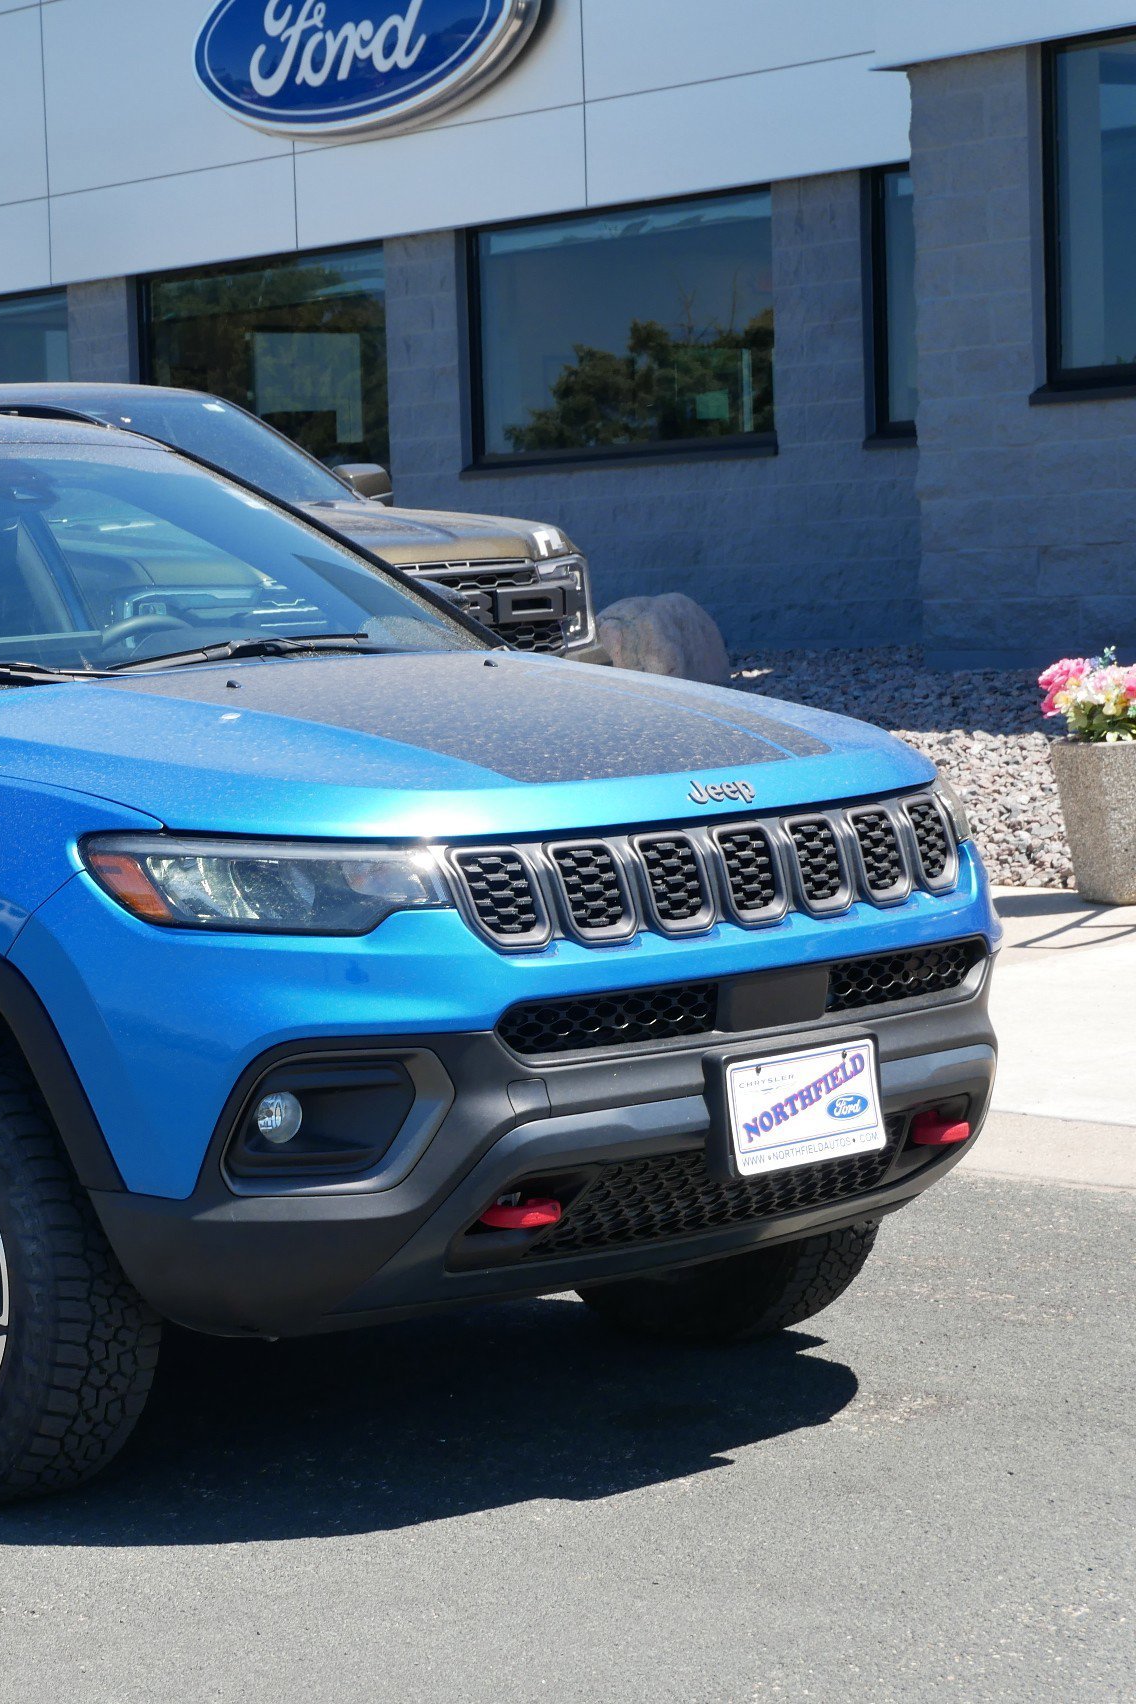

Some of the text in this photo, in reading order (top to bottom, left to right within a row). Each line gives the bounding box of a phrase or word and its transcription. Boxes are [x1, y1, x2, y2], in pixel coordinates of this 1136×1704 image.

[250, 0, 426, 97] Ford
[688, 780, 755, 804] Jeep
[739, 1074, 795, 1089] CHRYSLER
[742, 1053, 865, 1143] NORTHFIELD
[833, 1097, 862, 1115] Ford
